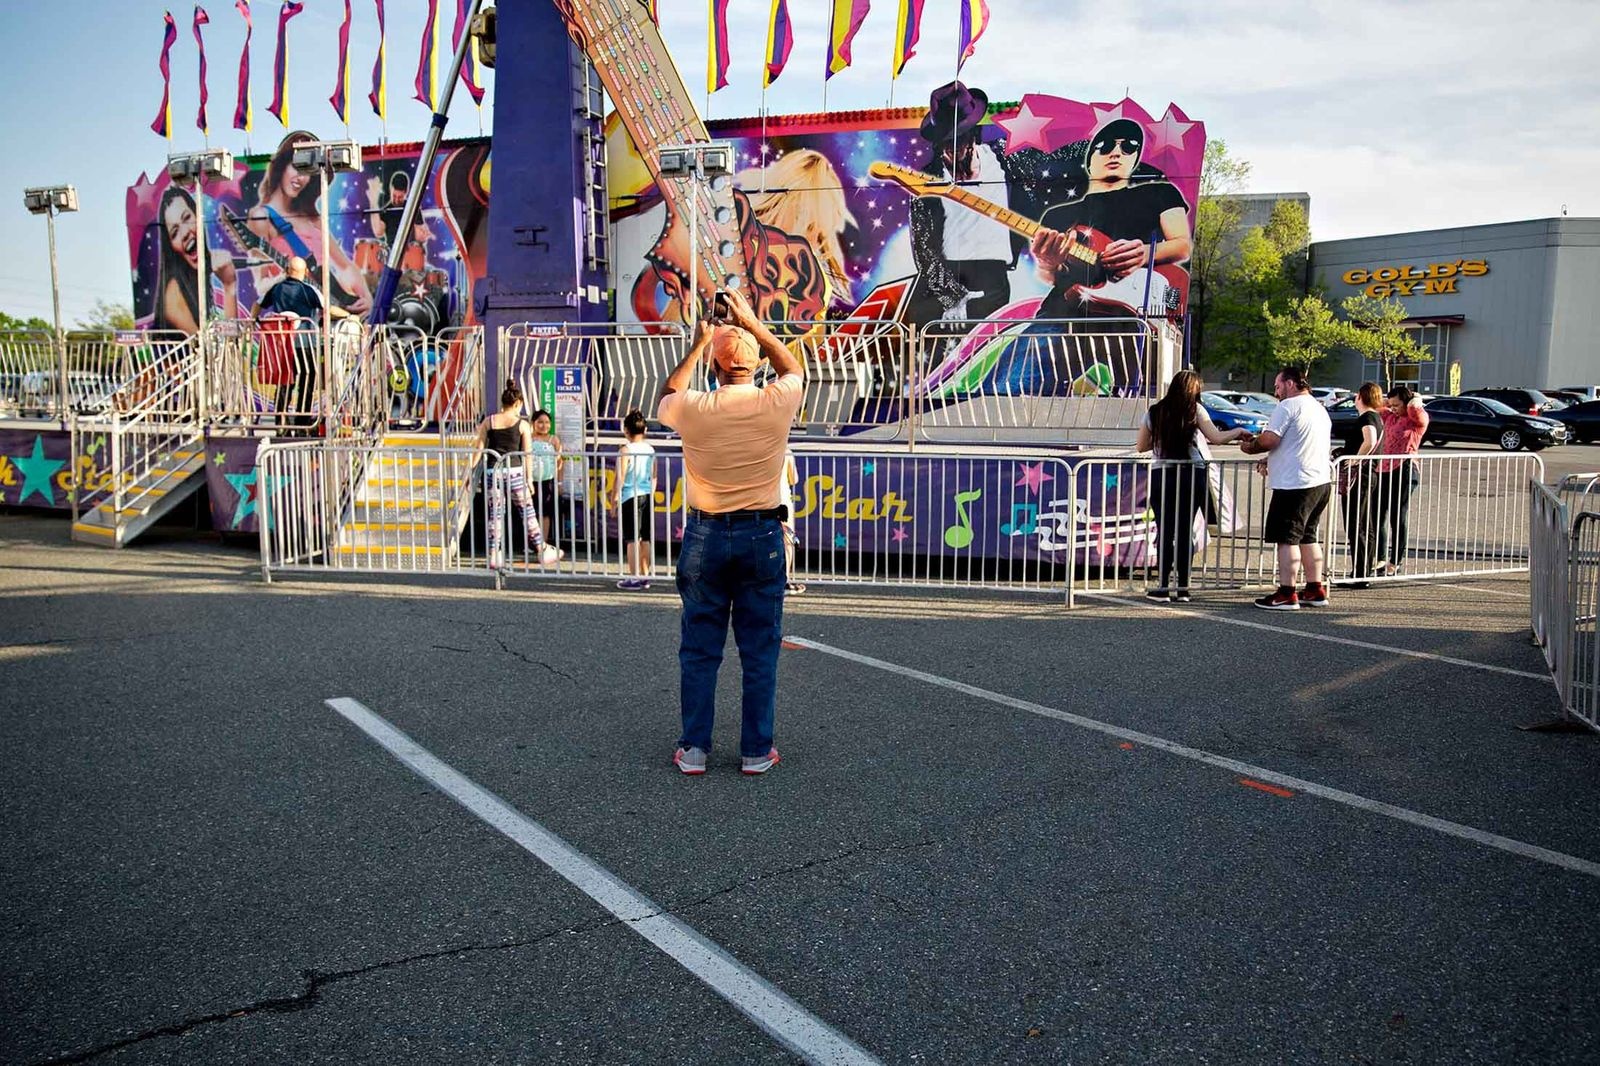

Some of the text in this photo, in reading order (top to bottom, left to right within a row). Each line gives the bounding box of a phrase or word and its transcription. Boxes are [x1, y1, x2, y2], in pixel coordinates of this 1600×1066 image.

[1342, 258, 1488, 284] GOLD'S
[1364, 278, 1458, 298] GYM
[563, 370, 574, 385] 5
[544, 380, 552, 413] YES
[791, 475, 913, 522] Star
